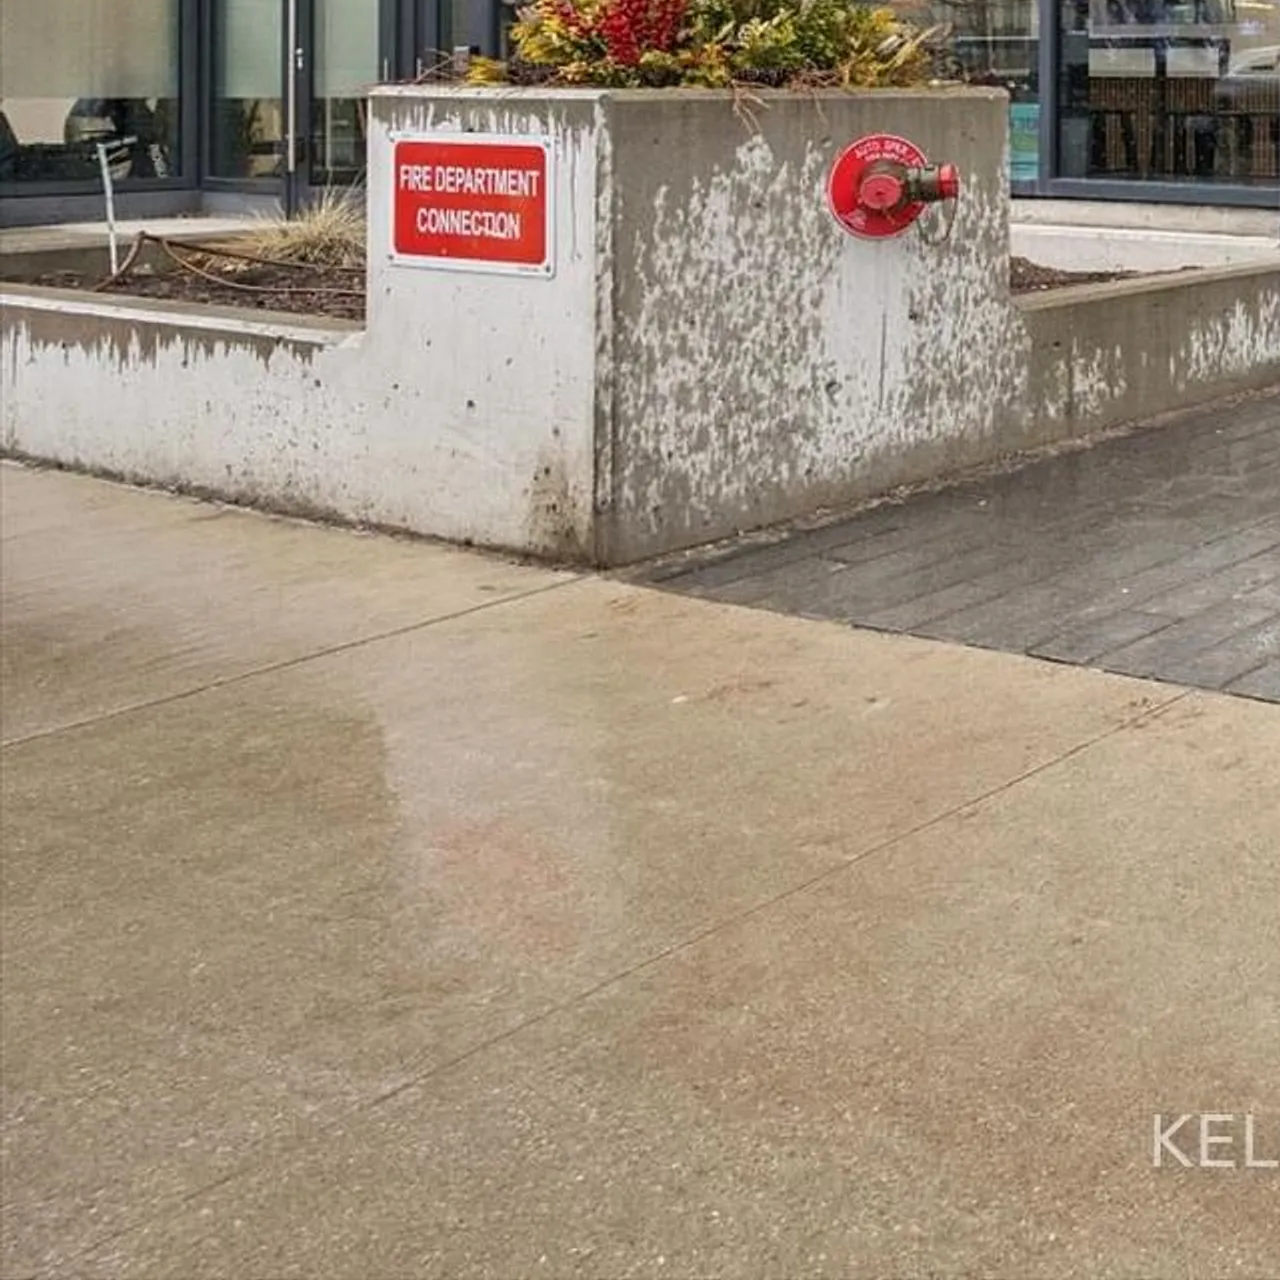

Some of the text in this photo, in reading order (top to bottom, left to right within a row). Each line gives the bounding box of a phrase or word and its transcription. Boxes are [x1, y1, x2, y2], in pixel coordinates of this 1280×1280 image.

[400, 164, 541, 197] FIRE DEPARTMENT
[416, 206, 522, 240] CONNECTION
